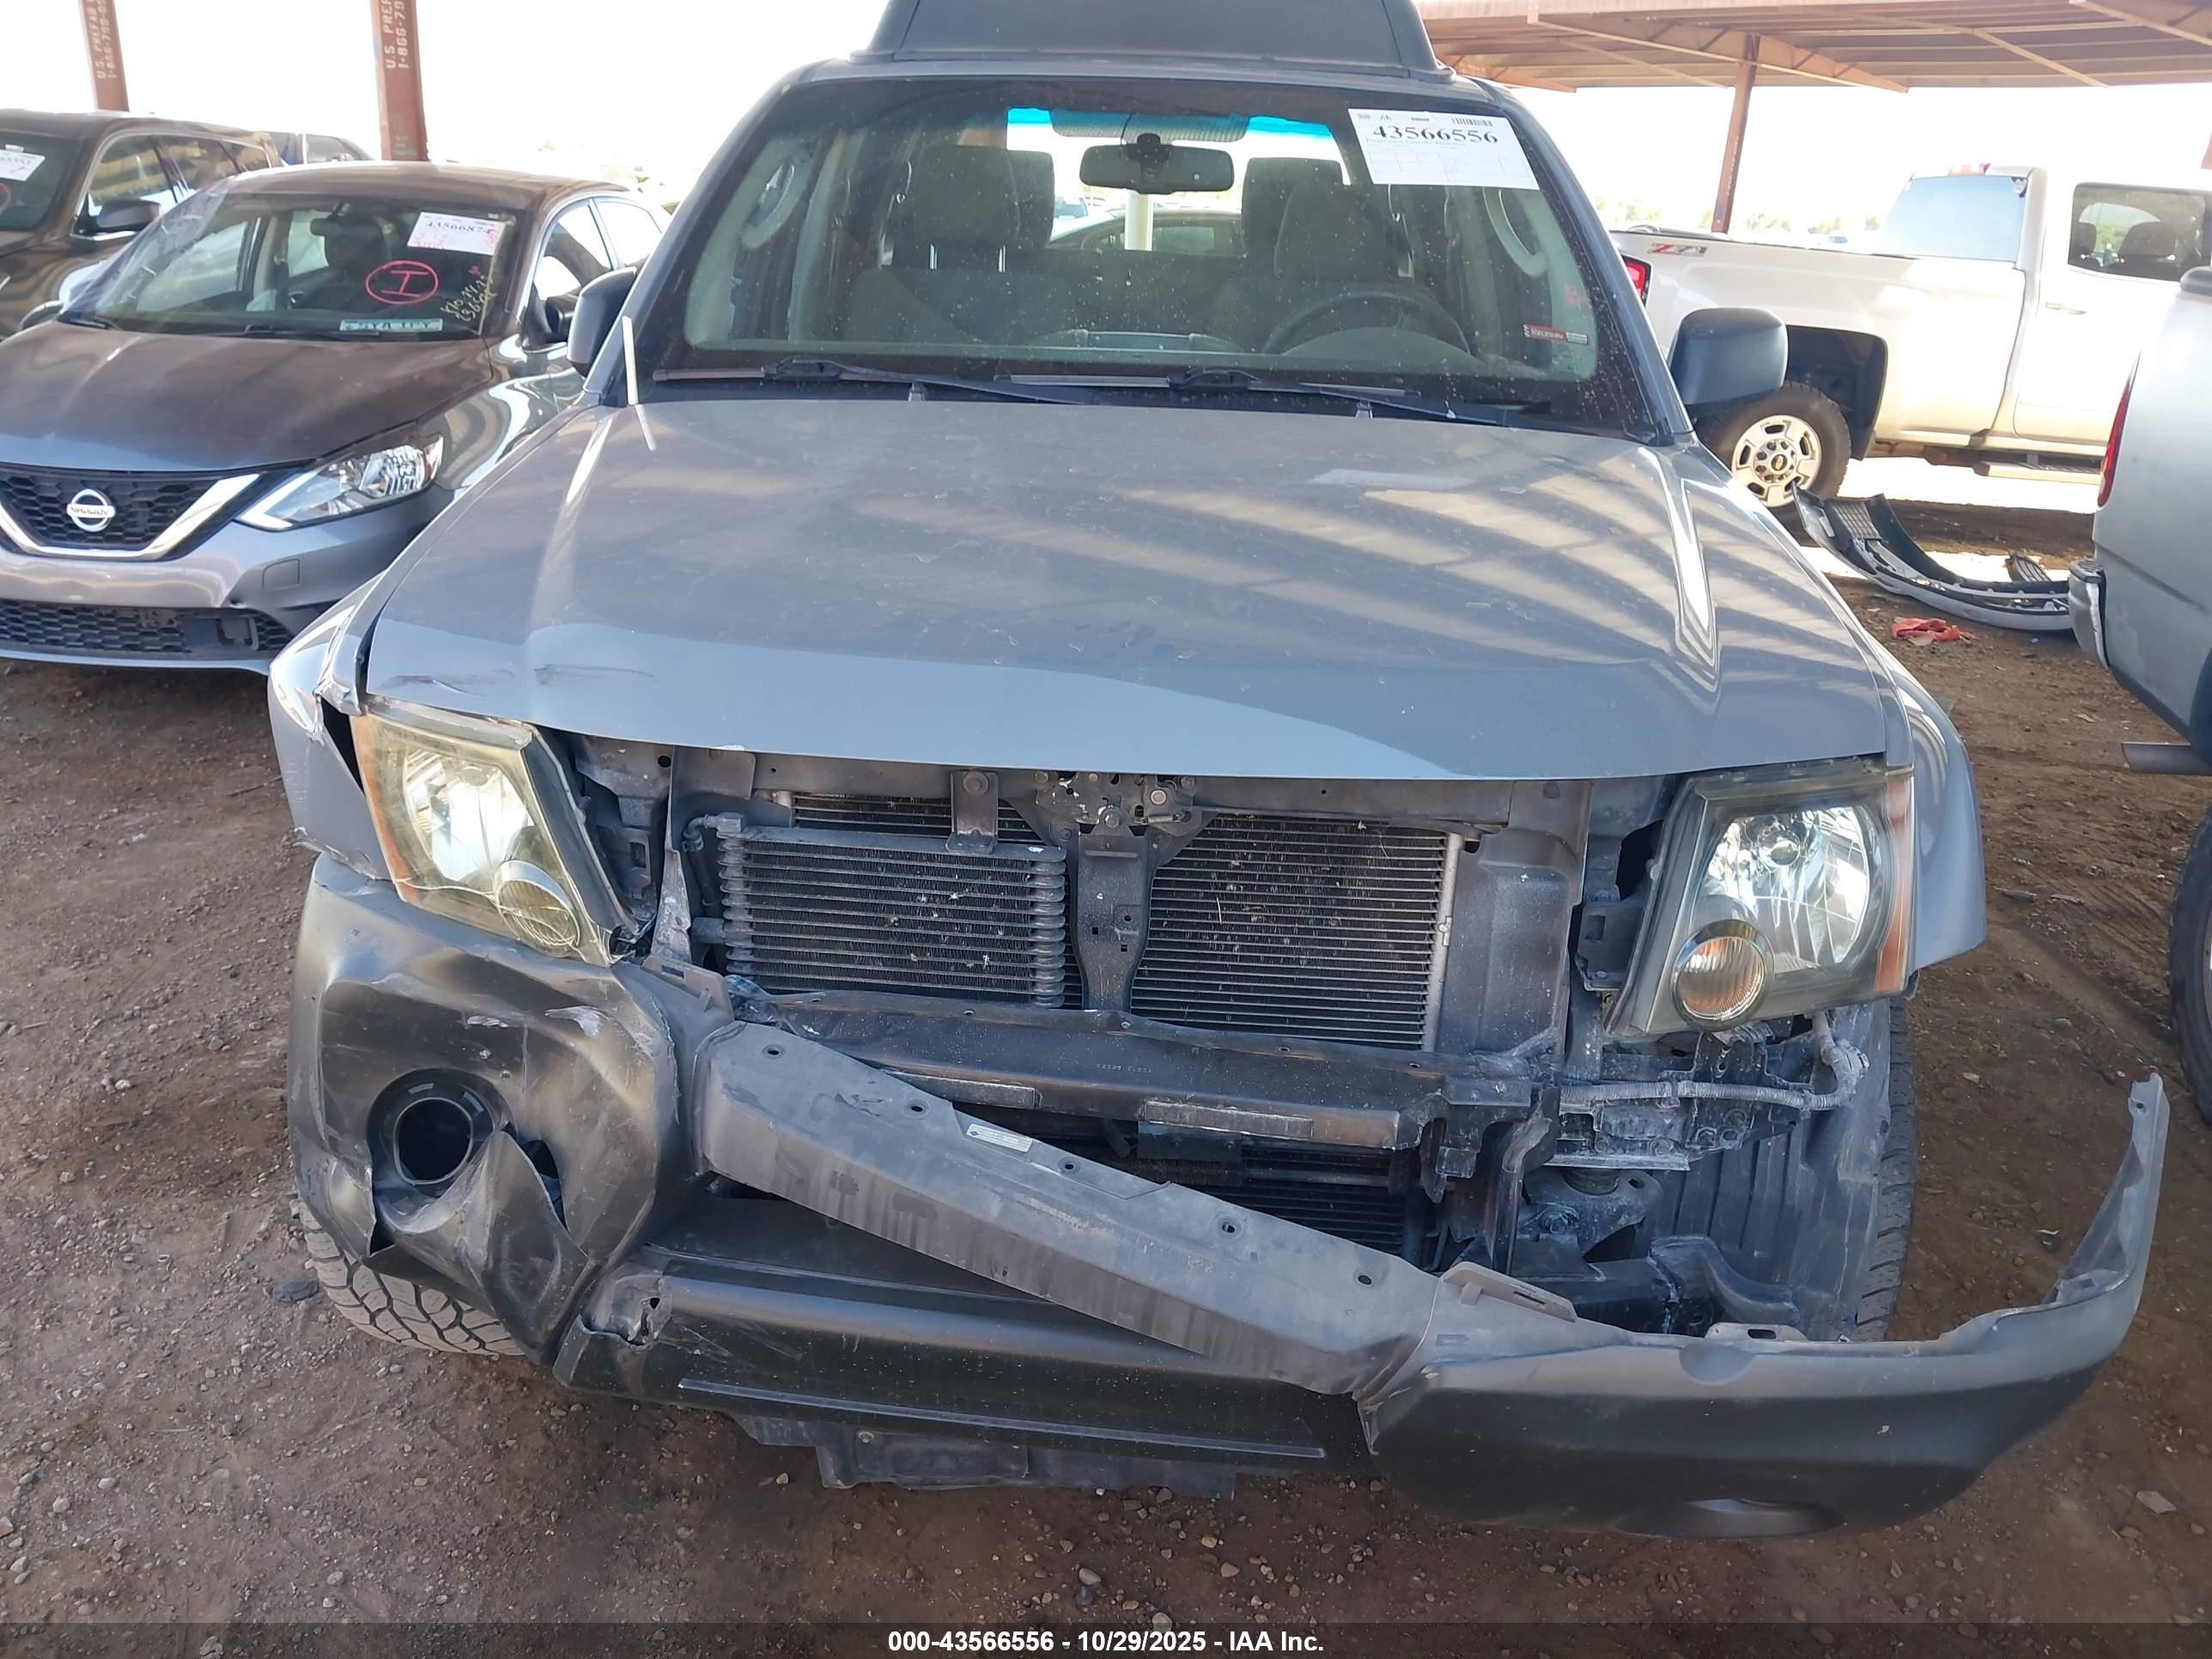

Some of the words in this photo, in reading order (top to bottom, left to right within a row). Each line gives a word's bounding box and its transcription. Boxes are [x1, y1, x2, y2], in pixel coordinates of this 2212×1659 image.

[384, 43, 397, 69] U.S.
[1373, 125, 1498, 143] 43566556
[1647, 242, 1709, 257] Z71
[70, 507, 108, 517] NISSAN
